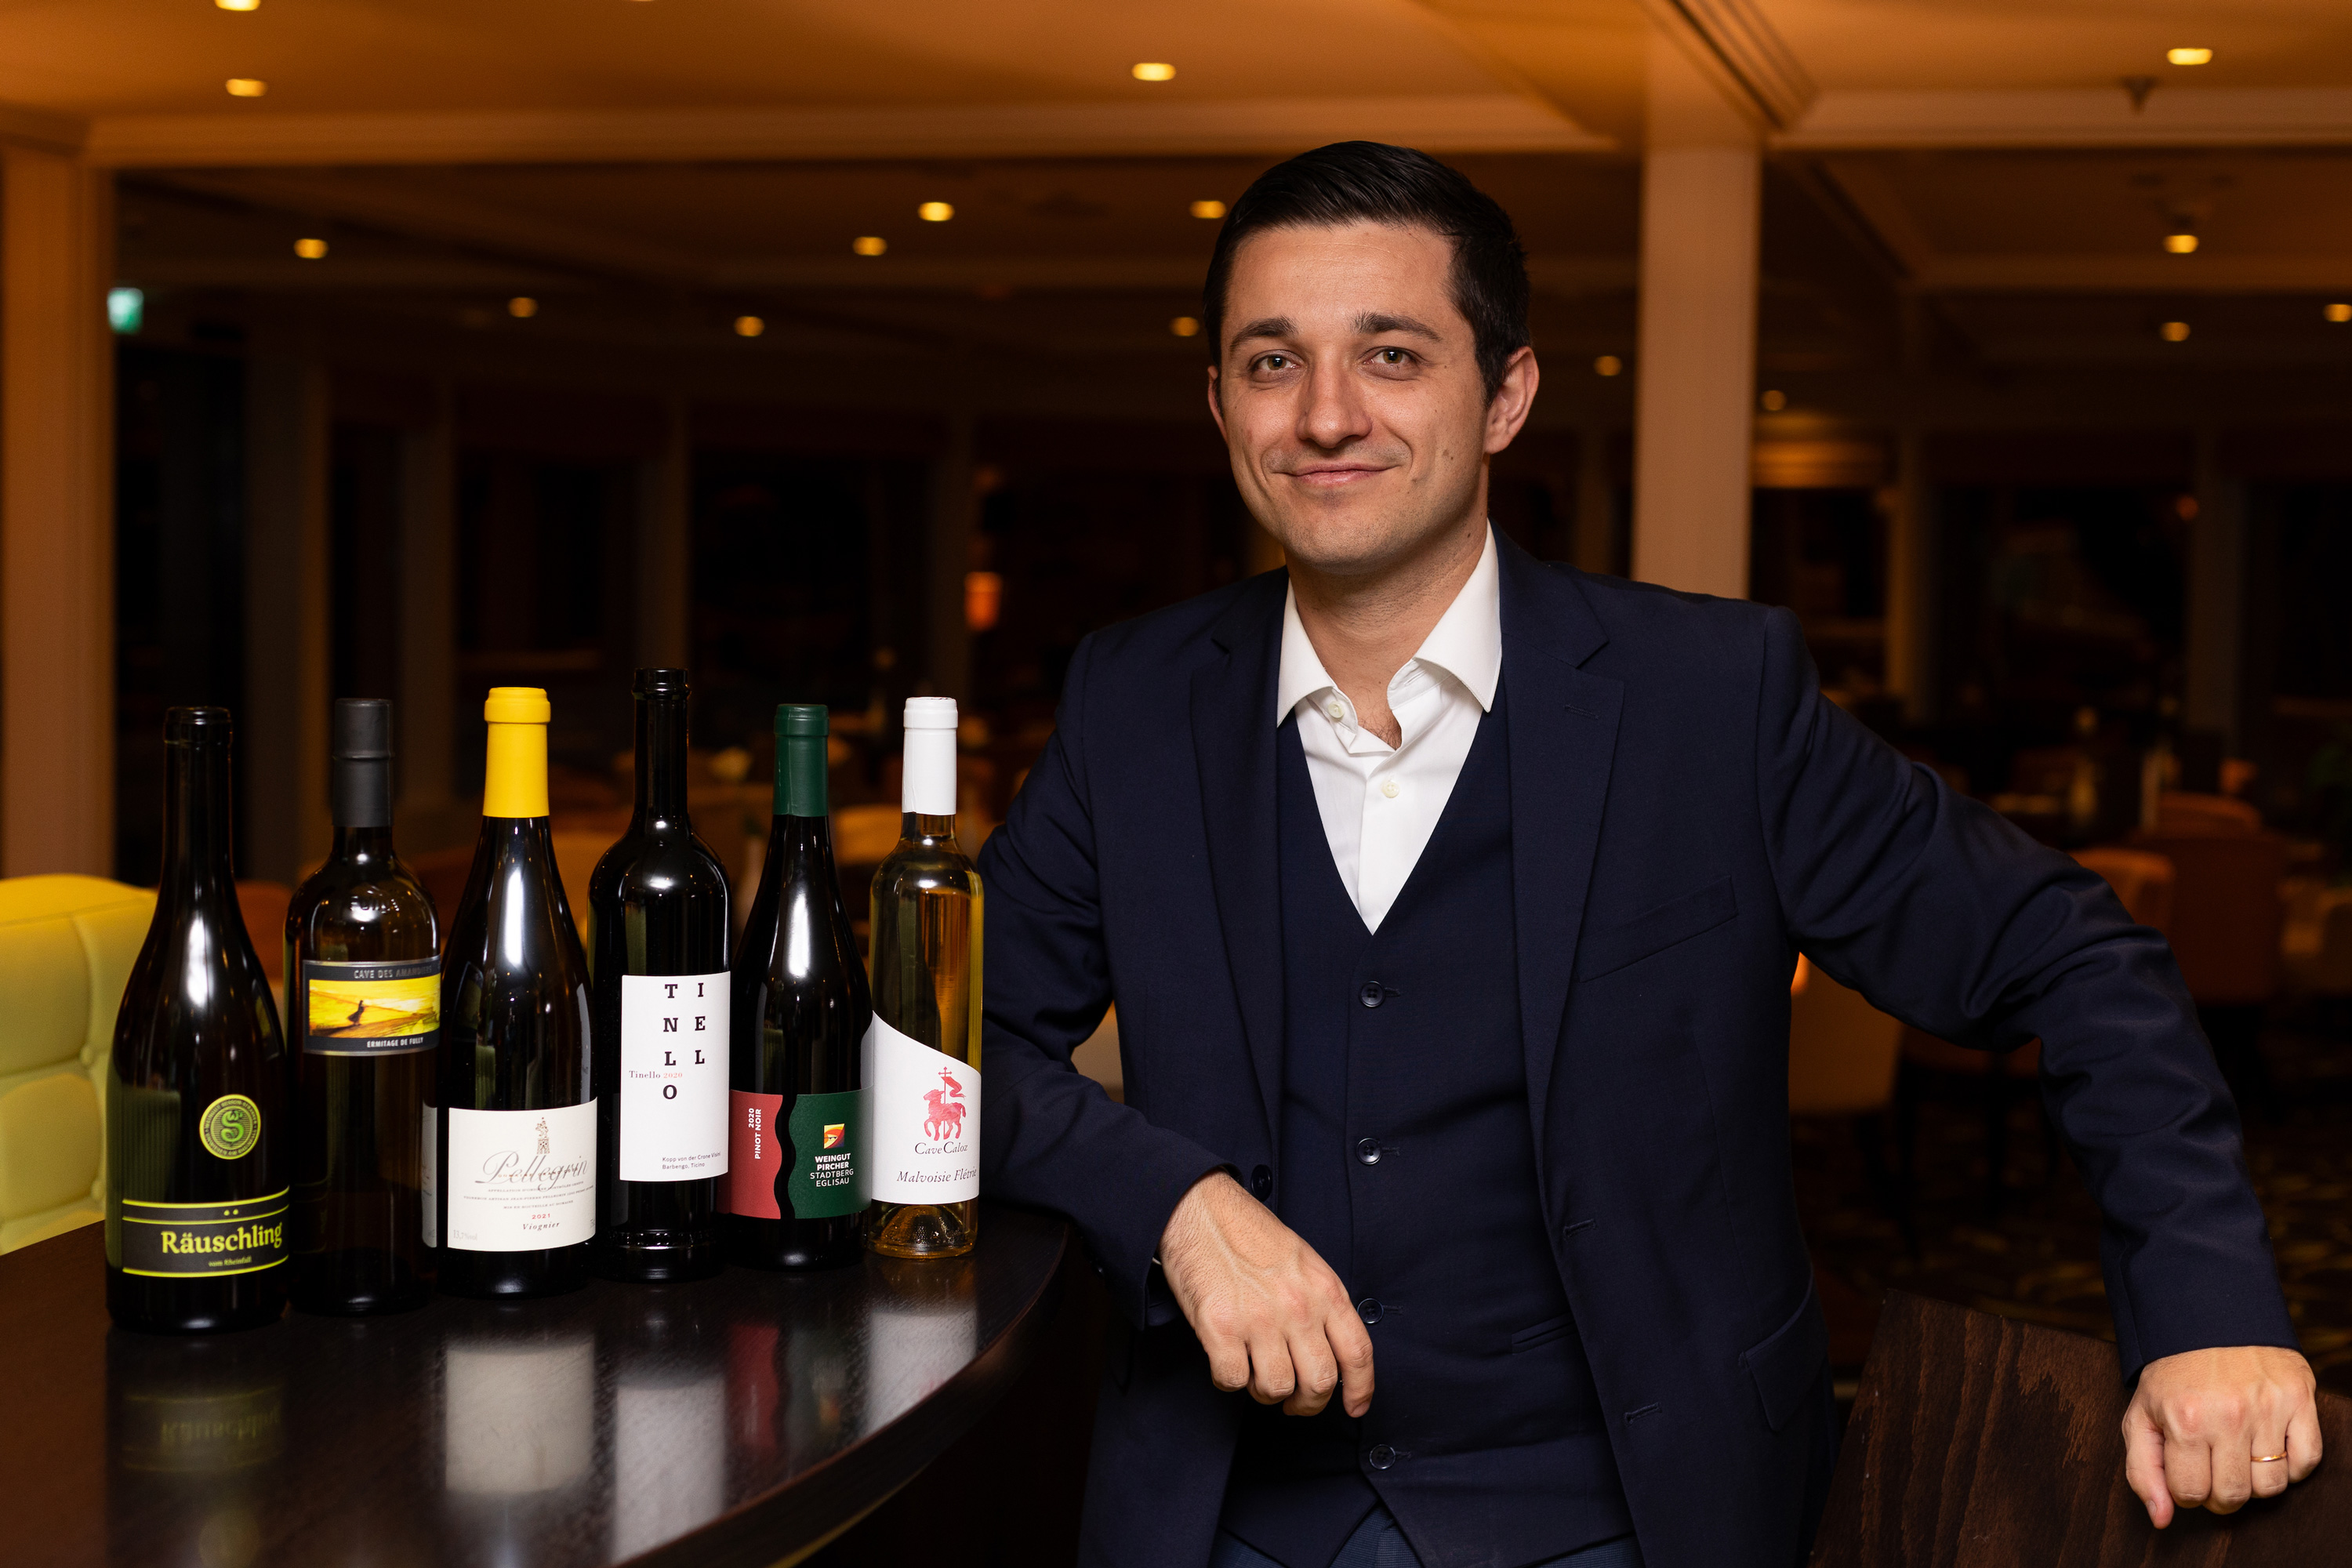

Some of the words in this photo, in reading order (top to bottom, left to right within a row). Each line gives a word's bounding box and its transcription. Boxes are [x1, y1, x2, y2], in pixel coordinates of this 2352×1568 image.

[354, 969, 375, 979] CAVE
[377, 969, 393, 978] DES
[367, 1039, 399, 1048] ERMITAGE
[409, 1036, 423, 1045] FULLY
[629, 1070, 661, 1079] Tinello
[914, 1142, 942, 1155] Cave
[943, 1141, 968, 1154] Caloz
[815, 1152, 851, 1163] WEINGUT
[474, 1149, 587, 1192] Pellegrin
[816, 1161, 849, 1171] PIRCHER
[810, 1168, 854, 1180] STADTBERG
[896, 1171, 951, 1183] Malvoisie
[953, 1166, 977, 1181] Flétrie
[816, 1177, 850, 1188] EGLISAU
[523, 1221, 560, 1231] Viognier
[161, 1221, 283, 1254] Räuschling
